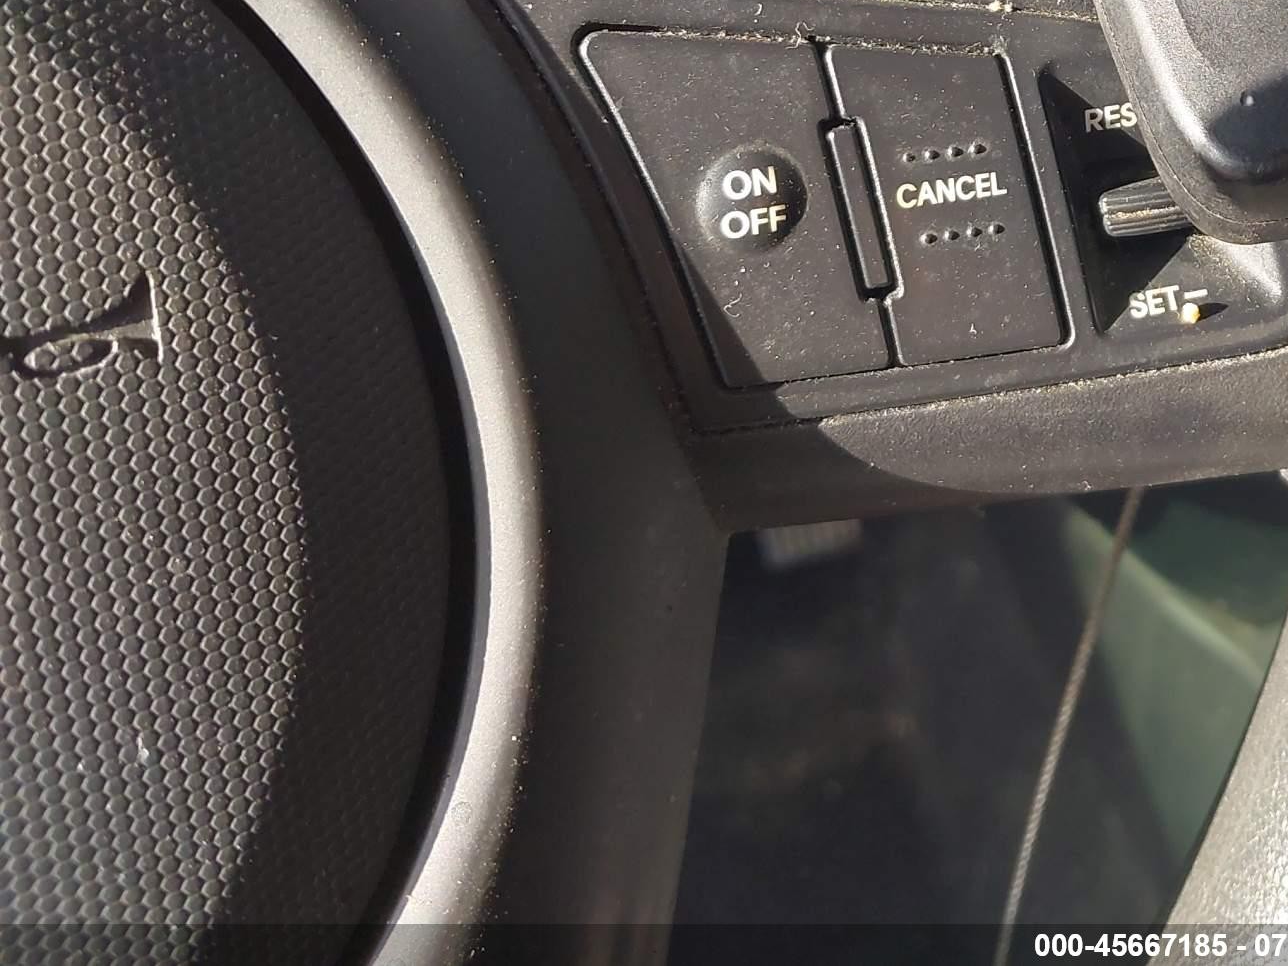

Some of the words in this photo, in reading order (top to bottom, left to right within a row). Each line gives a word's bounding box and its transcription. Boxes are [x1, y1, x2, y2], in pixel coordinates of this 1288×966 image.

[1085, 101, 1138, 132] RES
[722, 165, 778, 201] ON
[896, 171, 1008, 209] CANCEL
[720, 204, 787, 239] OFF
